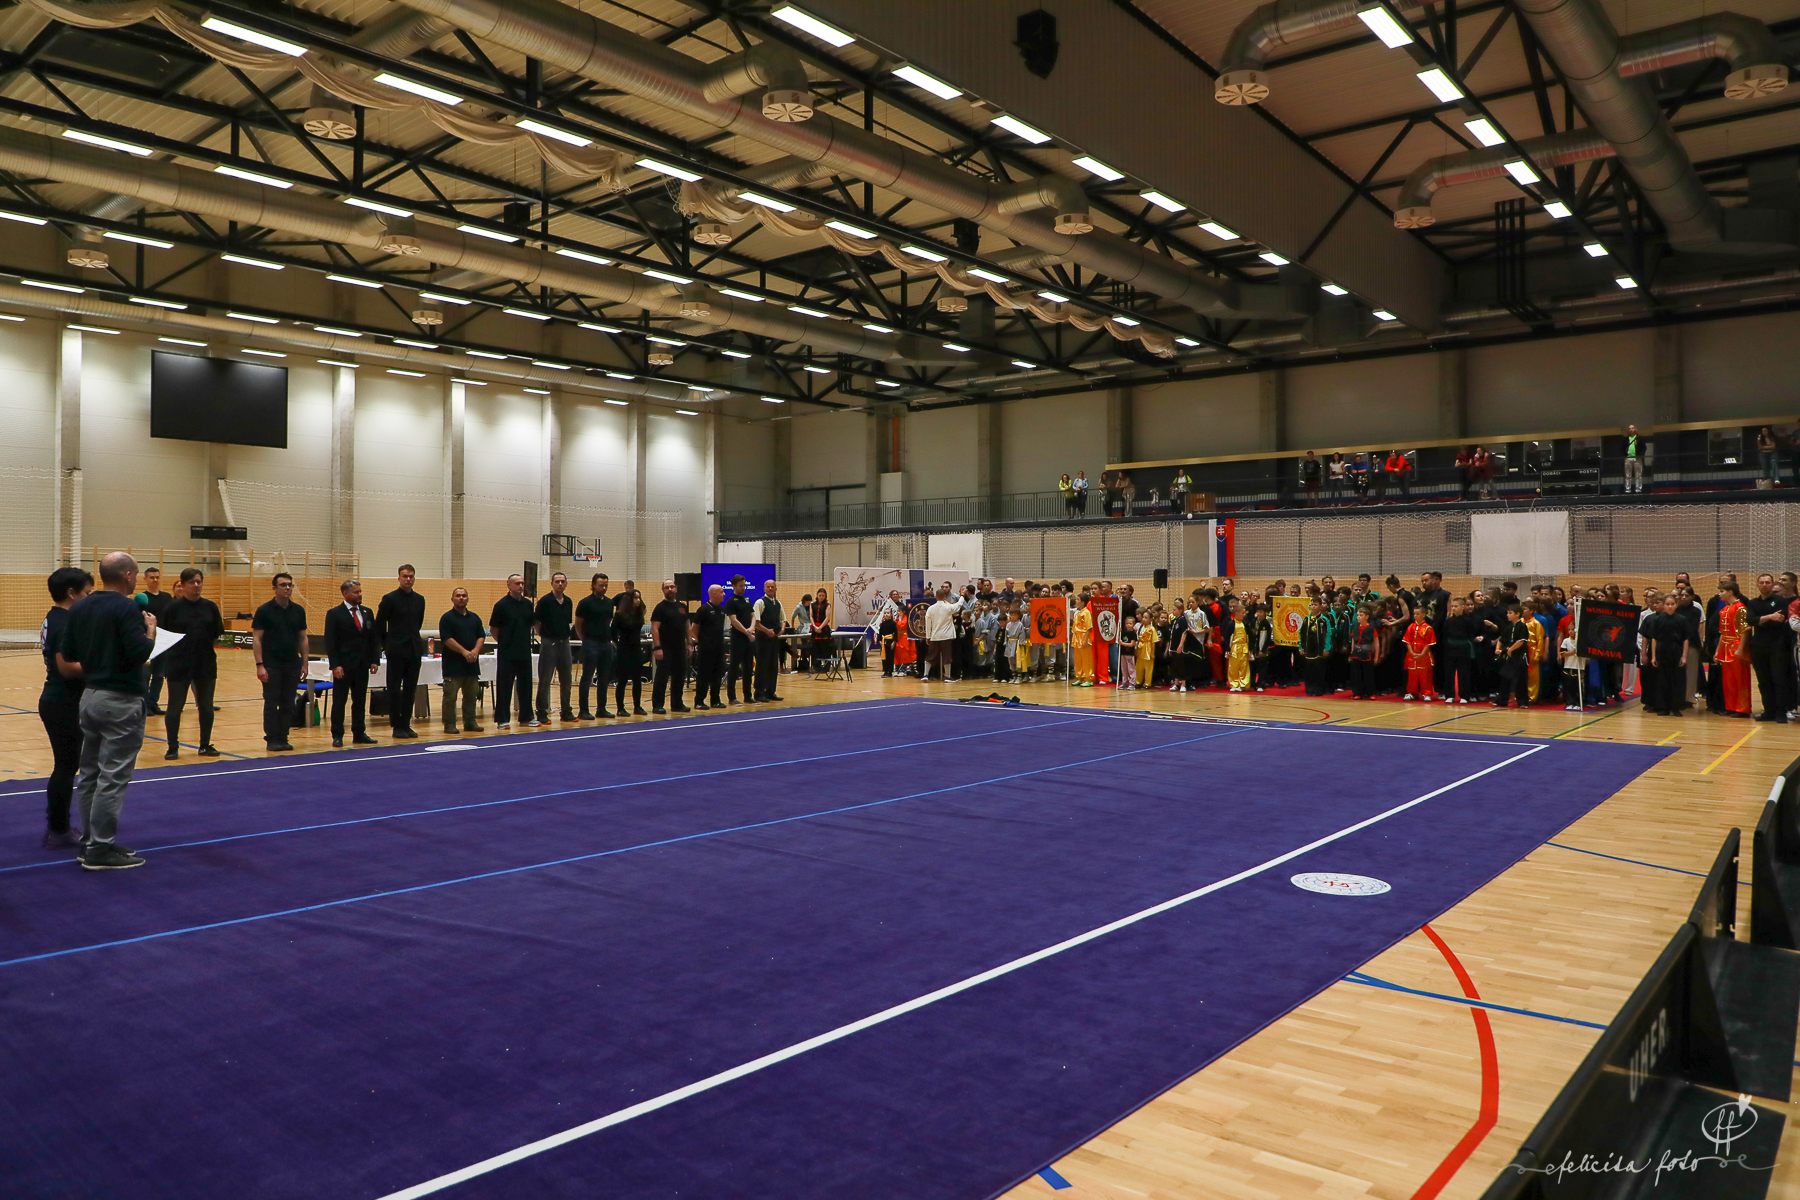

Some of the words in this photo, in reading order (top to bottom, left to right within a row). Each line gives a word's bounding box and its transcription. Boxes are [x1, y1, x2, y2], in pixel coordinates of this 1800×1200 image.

[1586, 606, 1613, 615] WUSHU
[234, 635, 254, 645] EXE
[1587, 647, 1622, 659] TRNAVA
